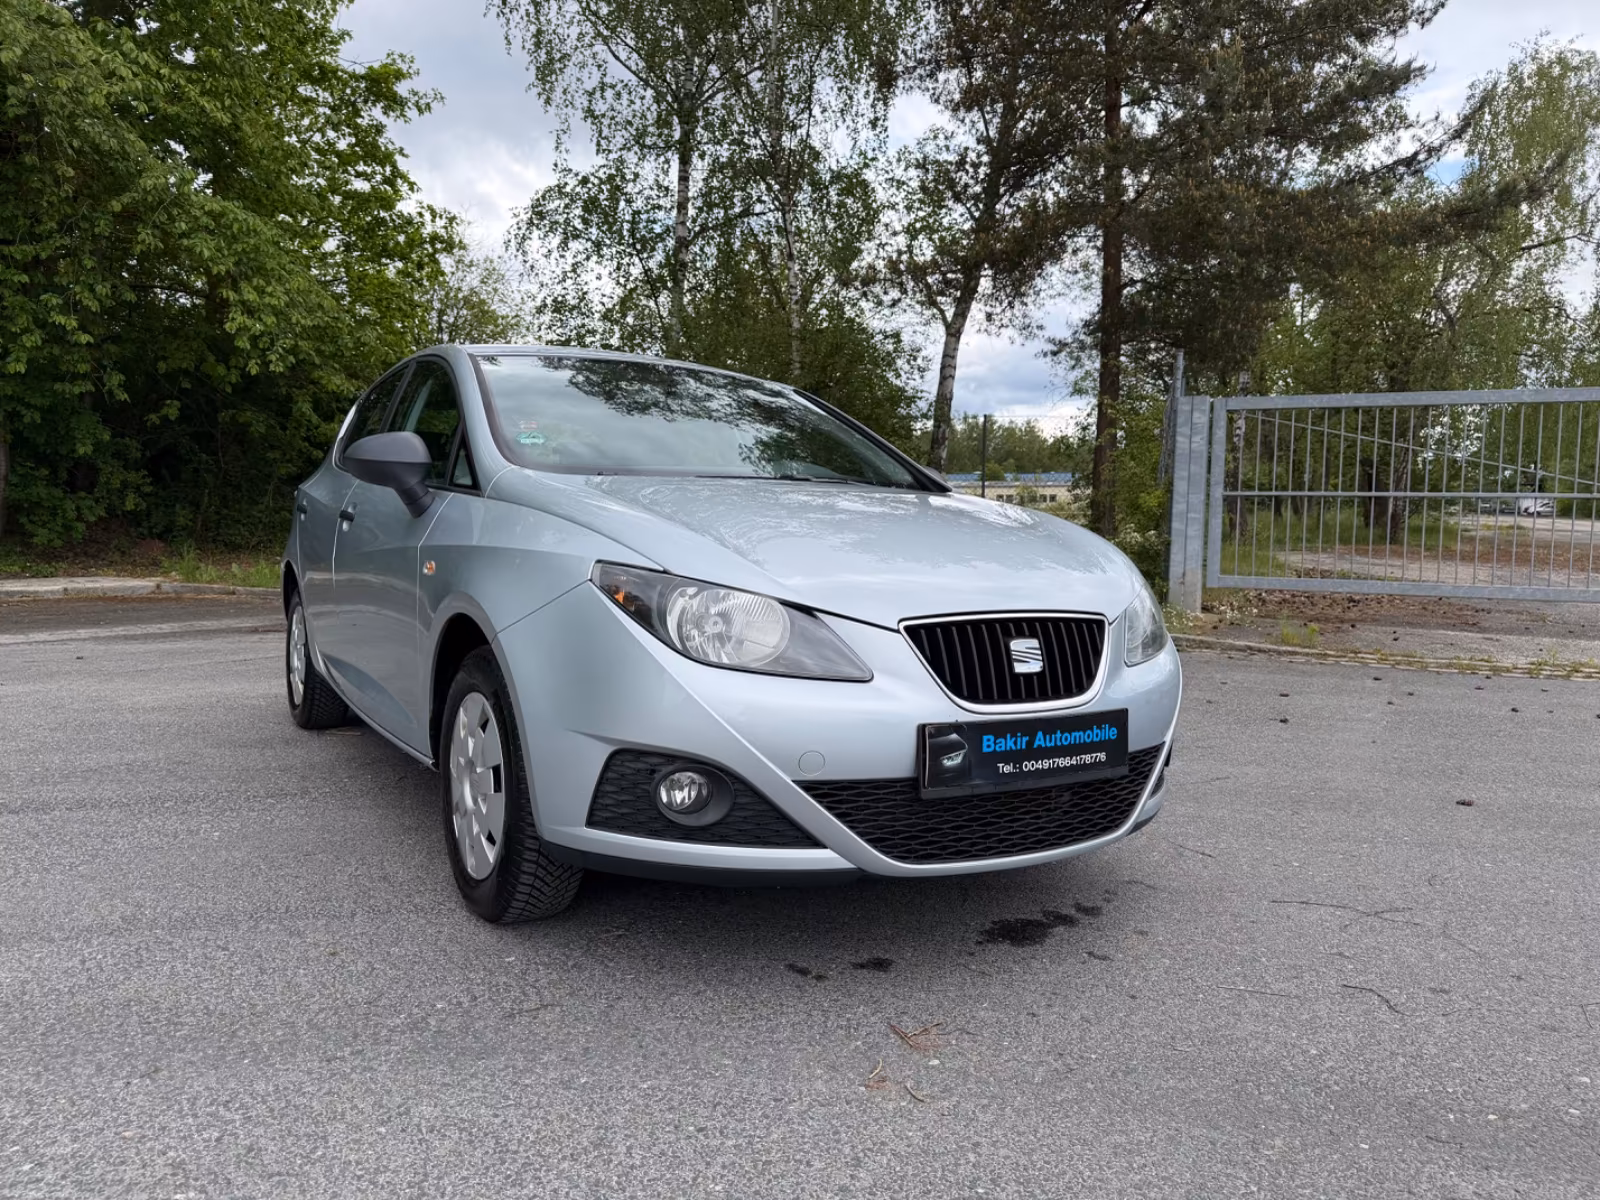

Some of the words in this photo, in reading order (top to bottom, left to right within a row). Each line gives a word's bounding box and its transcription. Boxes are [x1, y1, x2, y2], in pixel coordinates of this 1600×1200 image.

[982, 733, 1029, 753] Bakir
[1033, 724, 1118, 749] Automobile
[997, 763, 1020, 774] Tel.:
[1022, 752, 1107, 772] 004917664178776
